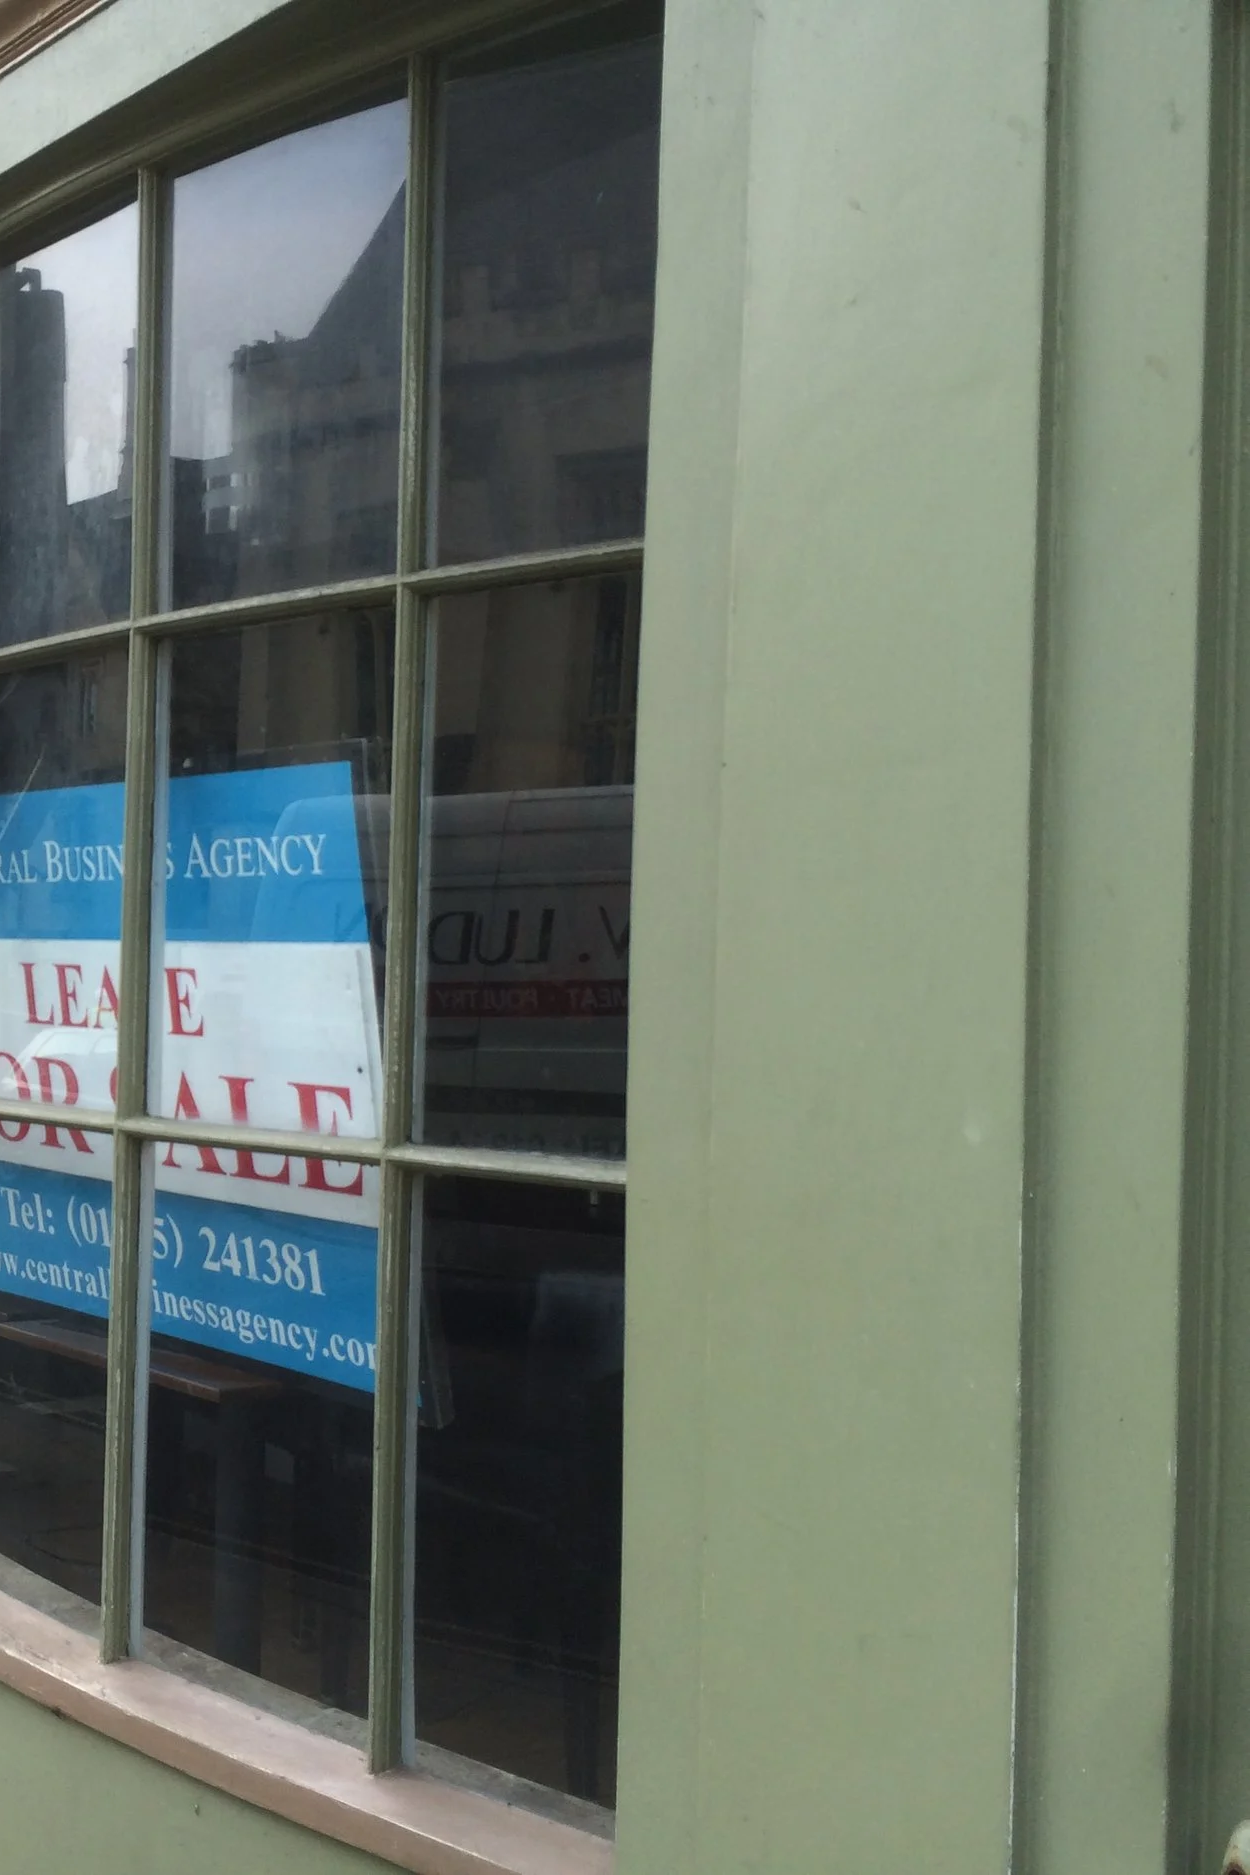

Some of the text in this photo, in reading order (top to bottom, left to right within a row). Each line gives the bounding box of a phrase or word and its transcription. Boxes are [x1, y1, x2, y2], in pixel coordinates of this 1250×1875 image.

[43, 840, 175, 882] BUSINS
[184, 833, 326, 879] AGENCY
[19, 962, 204, 1037] LEAE
[109, 1071, 364, 1197] ALE
[0, 1186, 326, 1296] Tel: (015) 241381
